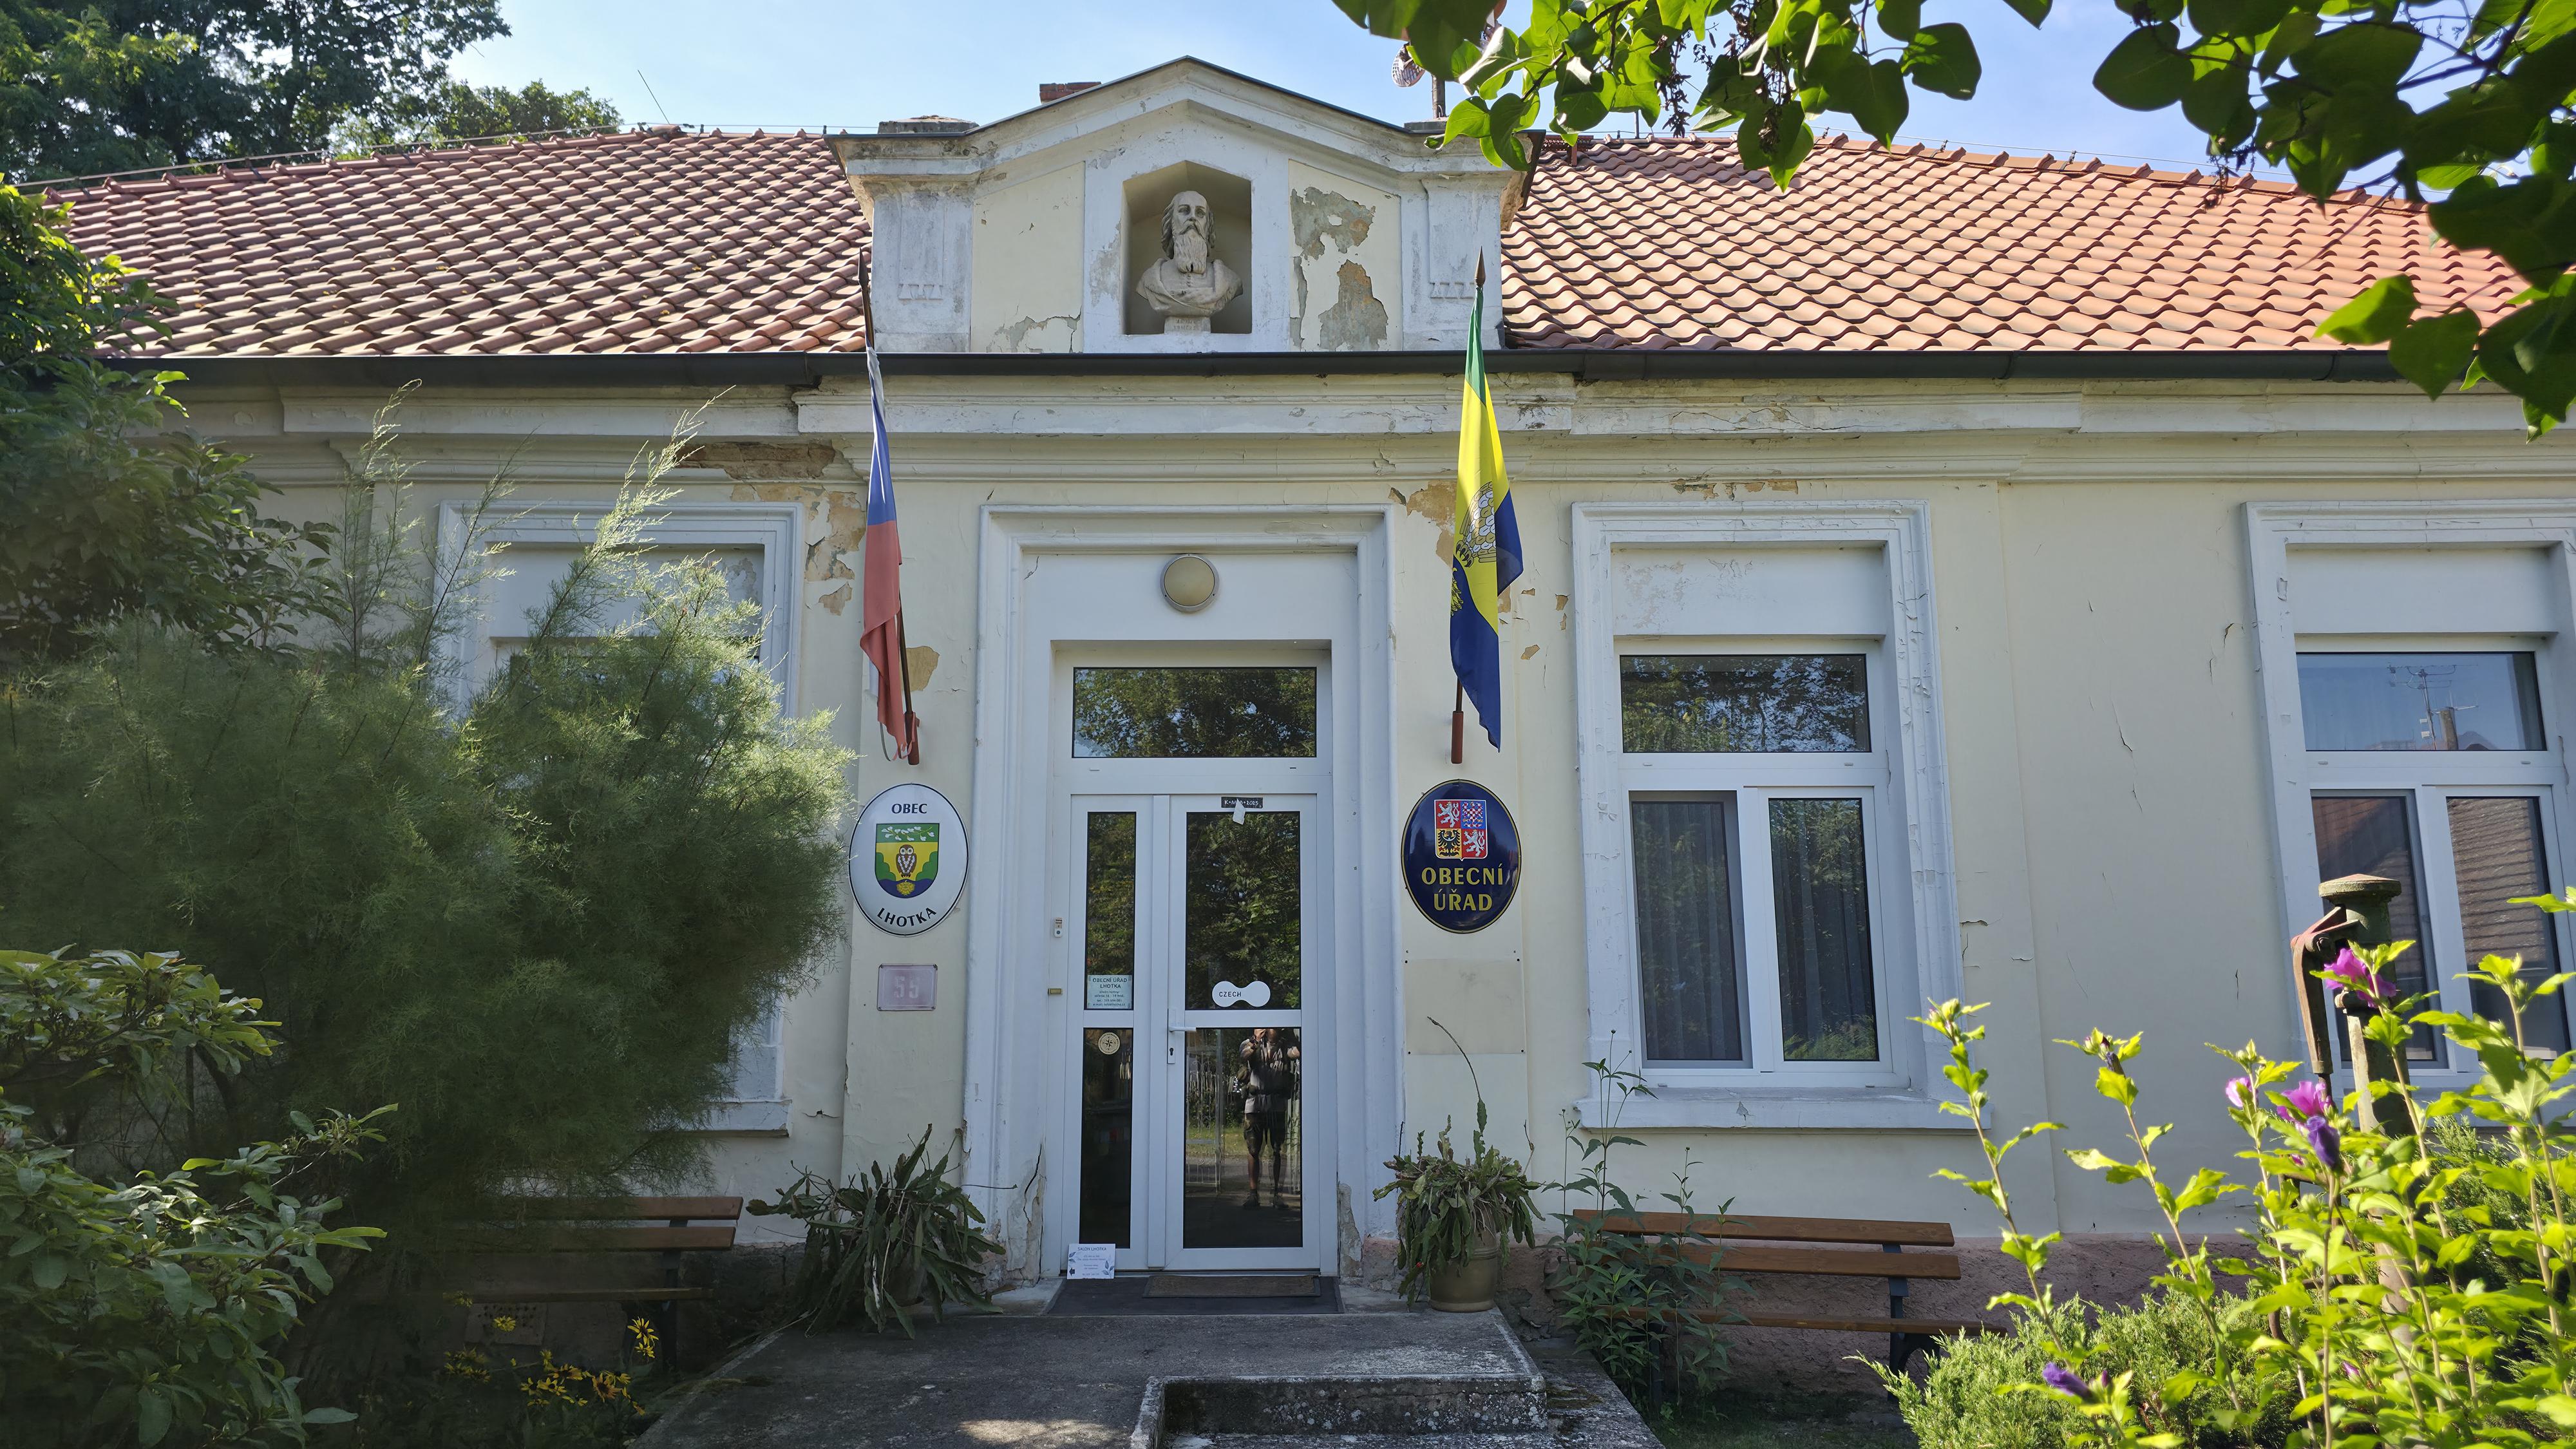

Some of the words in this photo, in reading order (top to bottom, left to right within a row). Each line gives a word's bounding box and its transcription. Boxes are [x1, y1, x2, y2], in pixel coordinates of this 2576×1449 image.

[891, 803, 927, 814] OBEC
[1421, 863, 1503, 885] OBECNÍ
[1434, 888, 1493, 911] ÚŘAD
[876, 907, 937, 927] LHOTKA
[893, 976, 920, 998] 55
